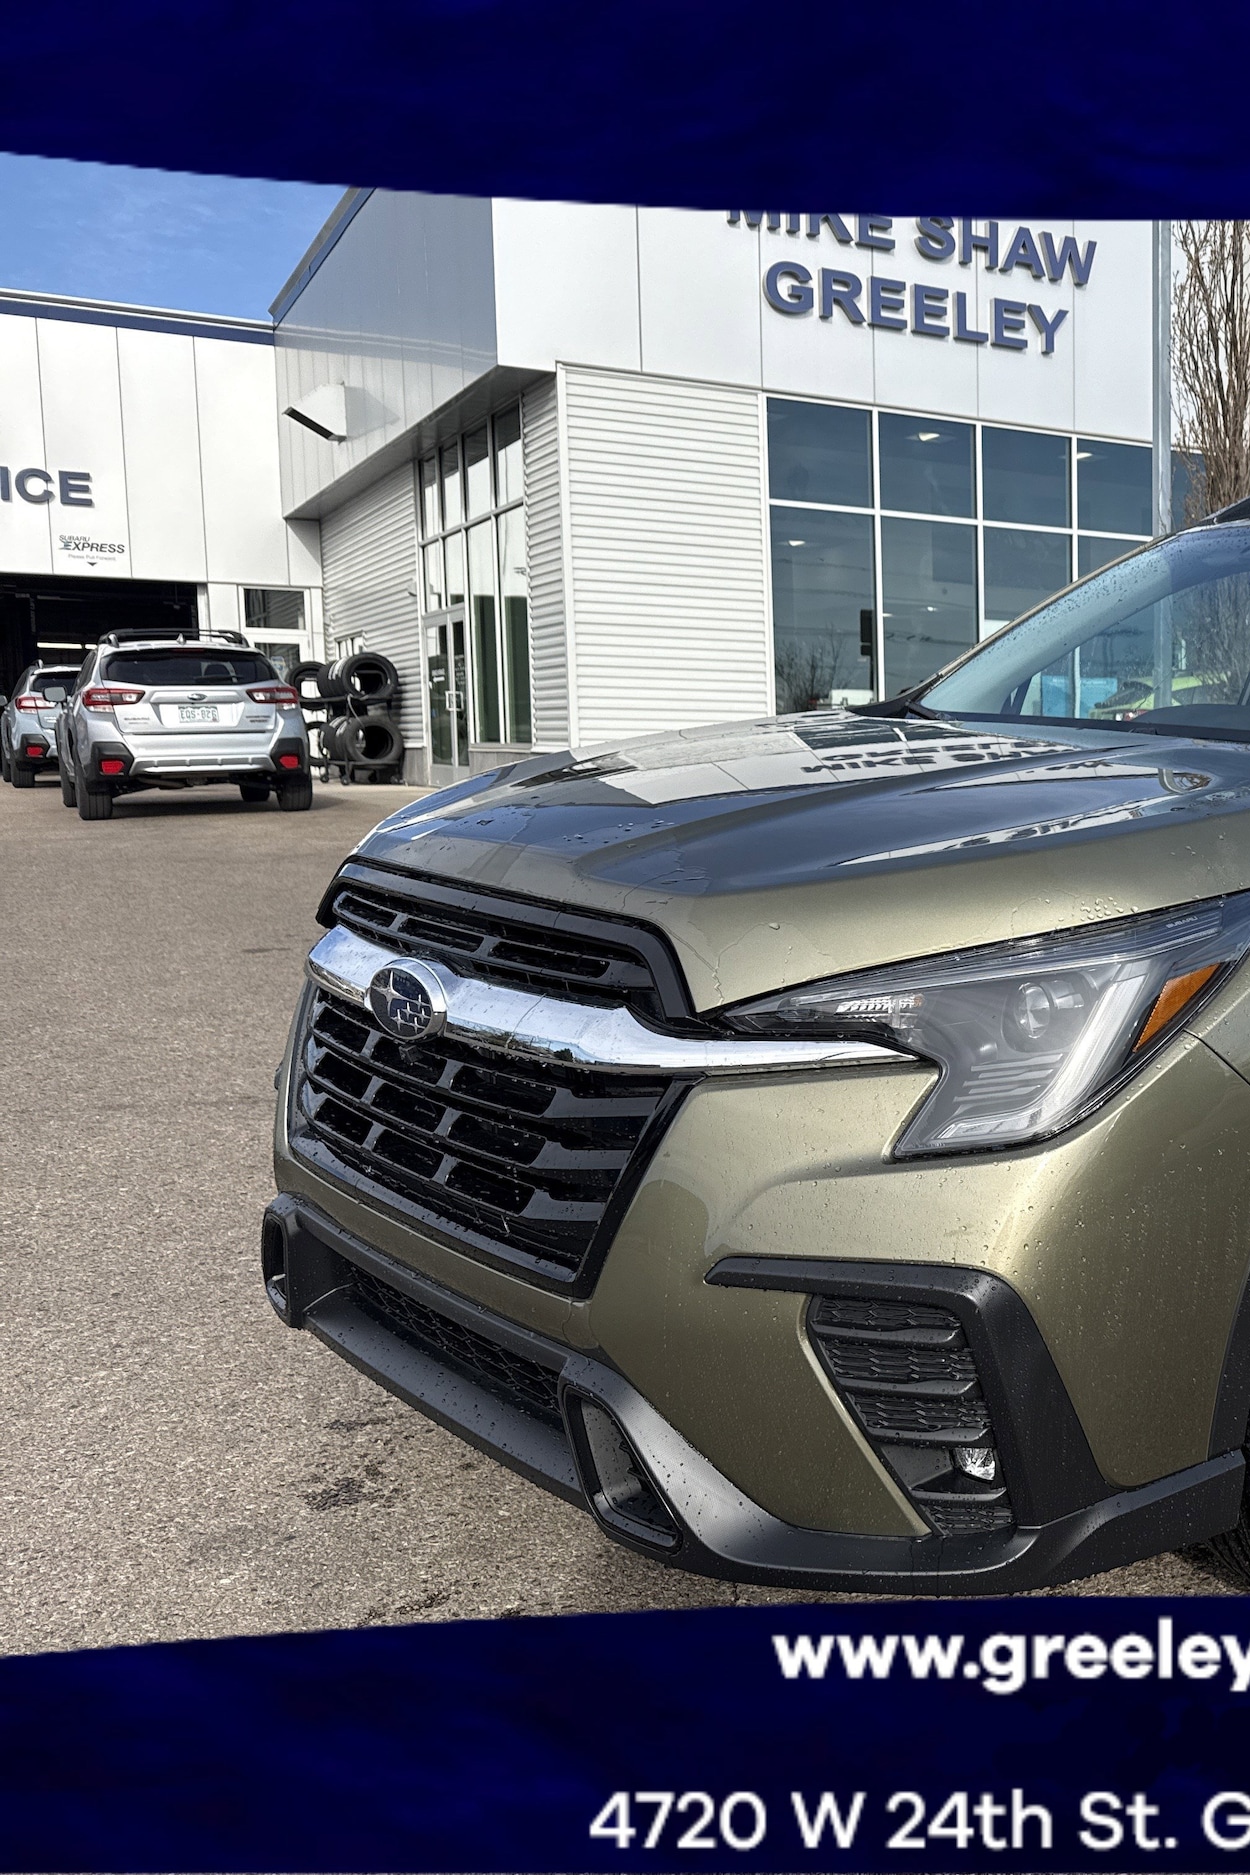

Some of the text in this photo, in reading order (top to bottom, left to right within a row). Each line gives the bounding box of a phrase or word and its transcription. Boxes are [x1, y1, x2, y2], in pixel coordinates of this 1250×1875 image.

[914, 215, 1098, 286] SHAW
[763, 260, 1069, 355] GREELEY
[59, 535, 90, 543] SUBARU
[59, 540, 126, 554] EXPRESS
